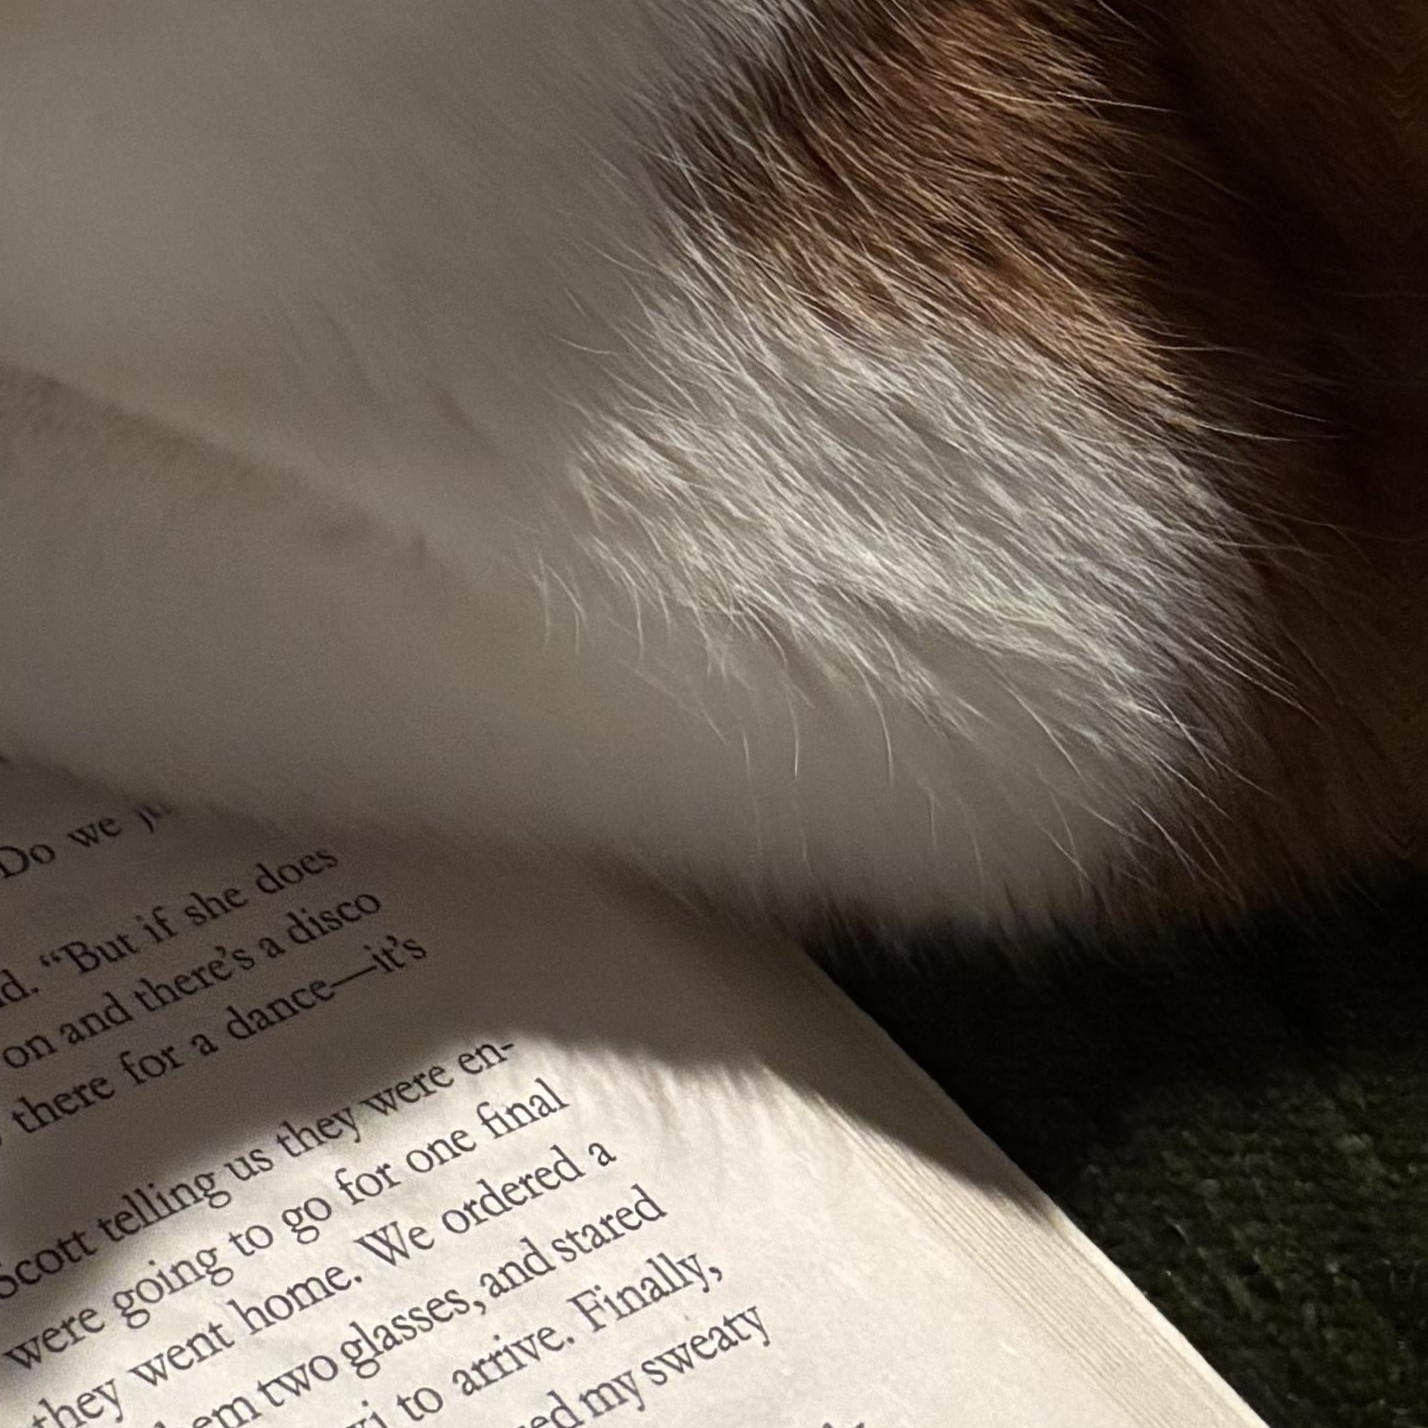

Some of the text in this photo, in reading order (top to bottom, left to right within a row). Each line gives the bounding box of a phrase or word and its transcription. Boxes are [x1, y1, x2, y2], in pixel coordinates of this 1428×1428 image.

[182, 887, 250, 928] she
[254, 848, 339, 896] does
[57, 990, 135, 1047] and
[132, 945, 257, 1013] there’s
[284, 893, 382, 946] disco
[10, 1076, 116, 1134] there
[117, 1045, 186, 1087] for
[96, 1171, 233, 1243] telling
[276, 1106, 362, 1158] they
[357, 1065, 455, 1117] were
[1, 1307, 106, 1370] were
[111, 1247, 235, 1330] going
[334, 1162, 403, 1206] for
[405, 1129, 477, 1174] one
[476, 1077, 570, 1140] final
[127, 1144, 587, 1387] went home. ordered
[256, 1183, 668, 1409] two glasses, and stared
[452, 1252, 723, 1397] arrive. Finally,
[640, 1305, 771, 1387] sweaty
